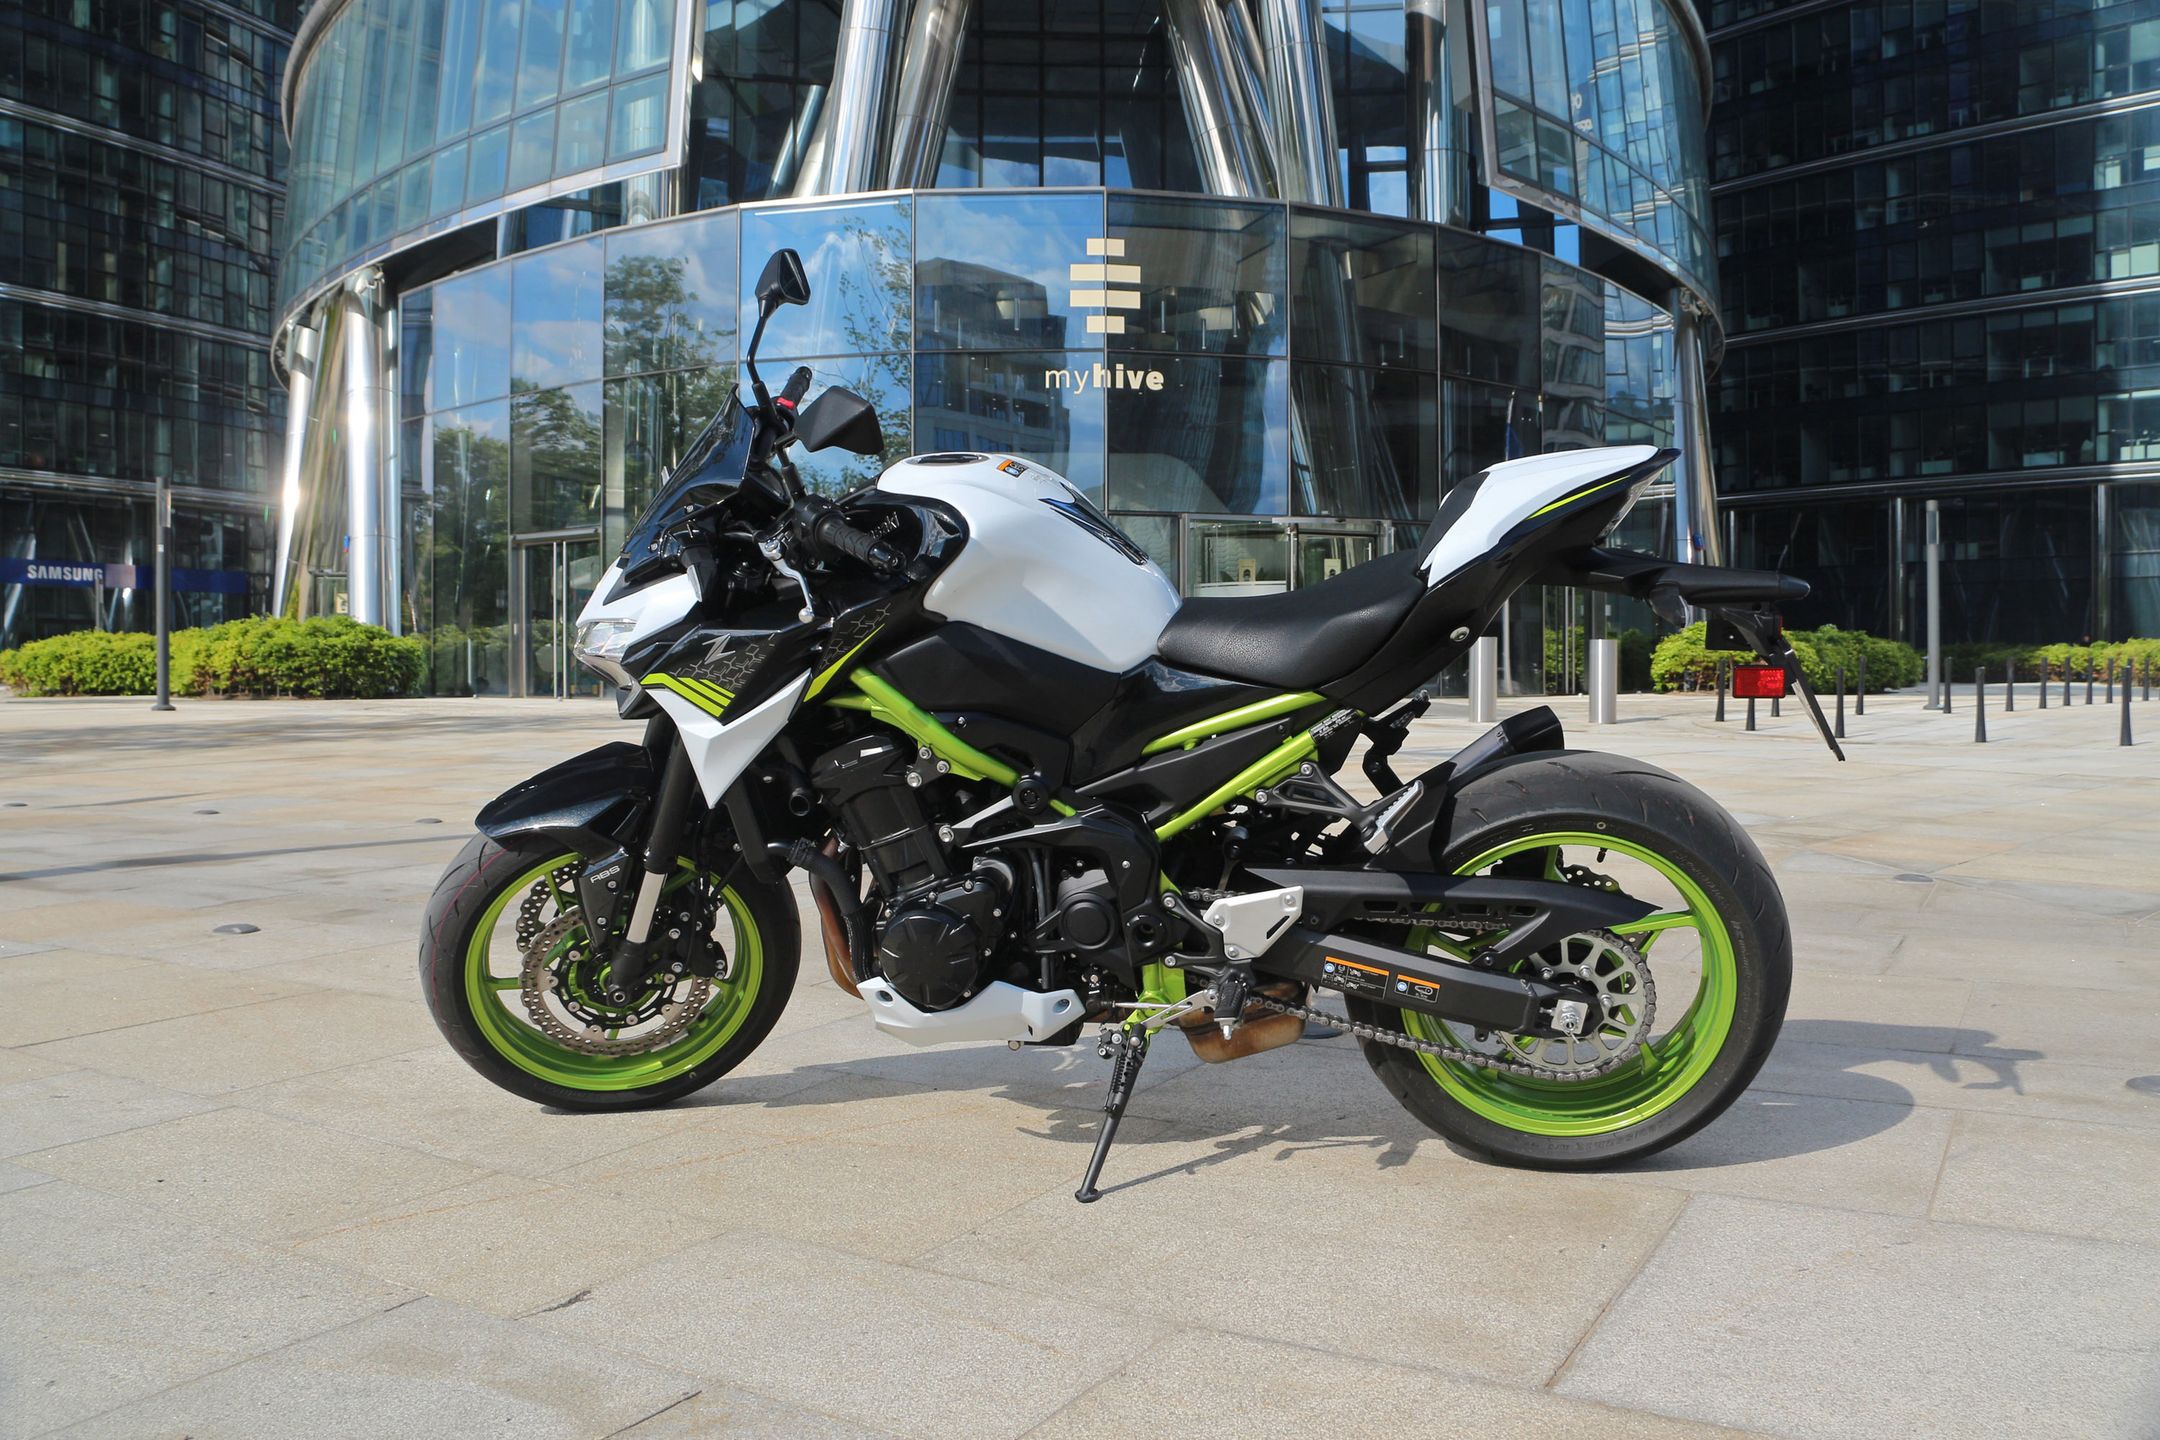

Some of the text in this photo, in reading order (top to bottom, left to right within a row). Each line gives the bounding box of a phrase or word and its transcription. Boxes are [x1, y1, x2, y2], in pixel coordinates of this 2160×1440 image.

[1045, 363, 1164, 394] myhive
[27, 564, 104, 581] SAMSUNG
[590, 865, 620, 884] ABS
